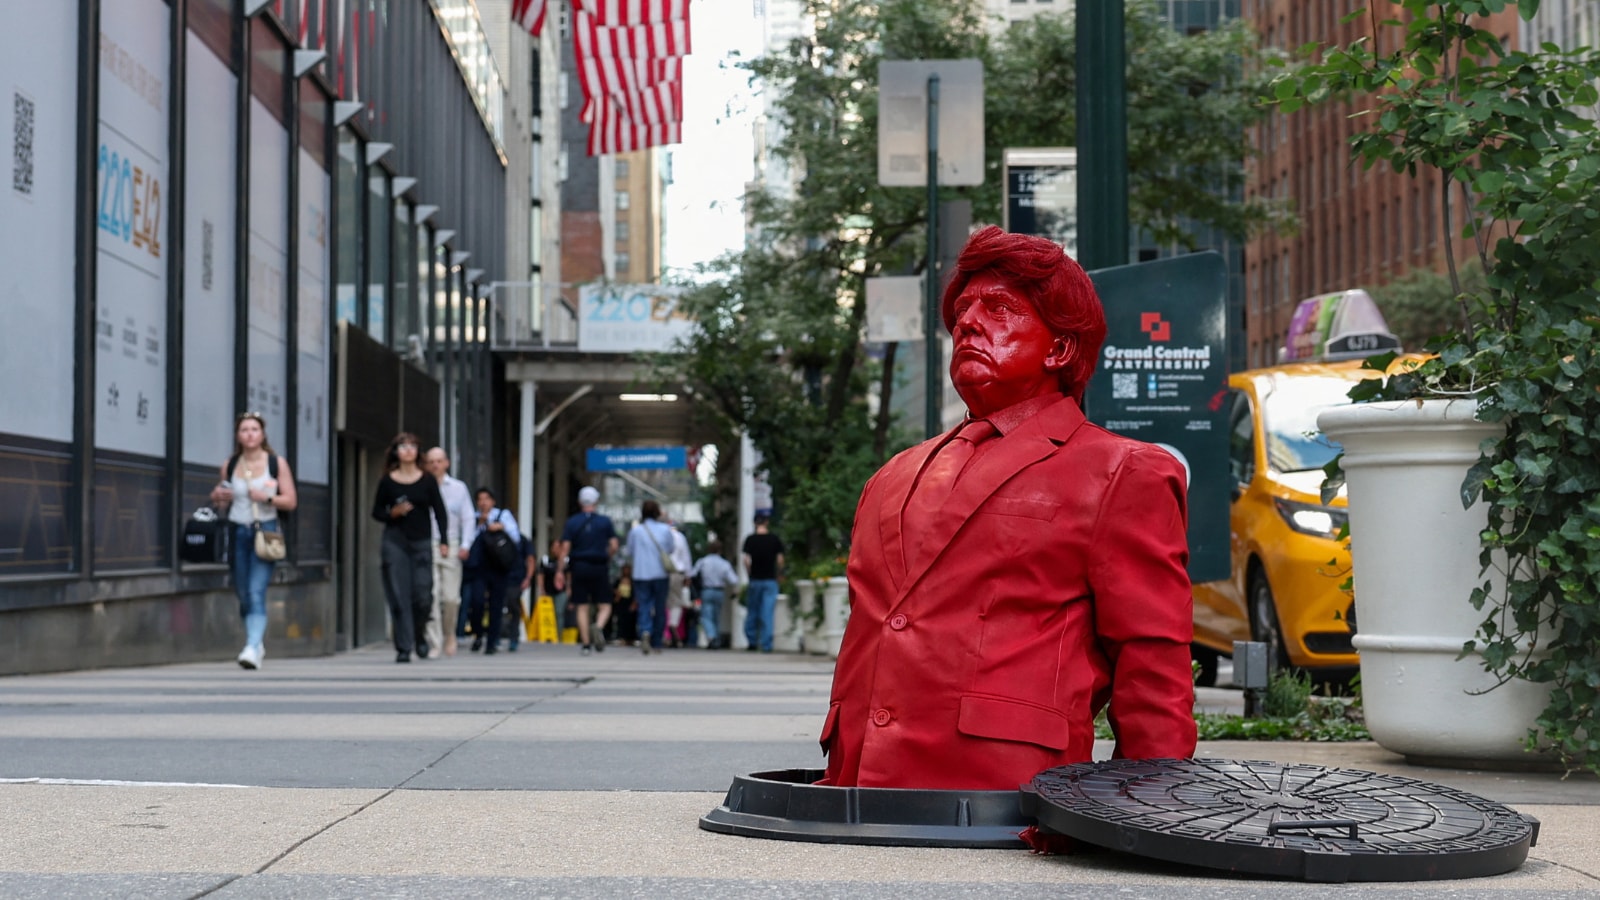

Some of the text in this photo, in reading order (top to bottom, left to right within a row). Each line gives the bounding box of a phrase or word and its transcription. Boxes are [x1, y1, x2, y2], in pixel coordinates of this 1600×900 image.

[97, 144, 160, 259] 220E42
[1104, 345, 1210, 359] Grand Central
[1103, 360, 1211, 370] PARTNERSHIP
